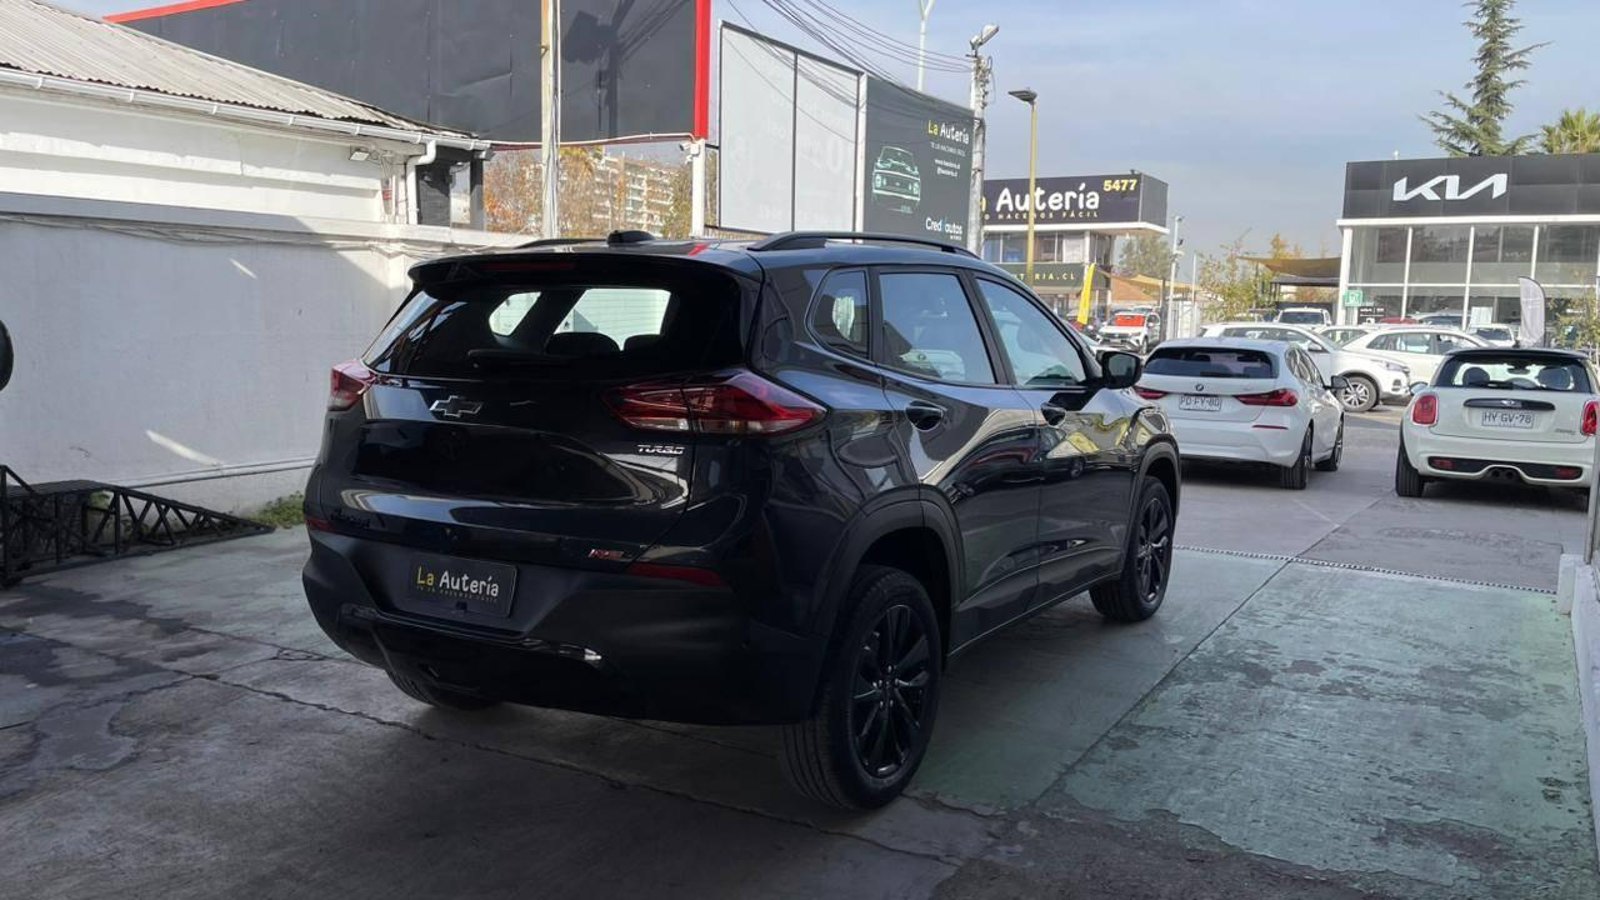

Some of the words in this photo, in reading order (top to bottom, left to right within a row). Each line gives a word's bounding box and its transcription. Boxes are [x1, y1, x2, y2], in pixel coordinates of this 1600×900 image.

[928, 120, 938, 135] La
[940, 123, 969, 144] Autería
[996, 182, 1100, 213] Autería
[1103, 179, 1137, 192] 5477
[1393, 173, 1507, 201] KIA
[417, 566, 434, 586] La
[439, 570, 499, 597] Autería
